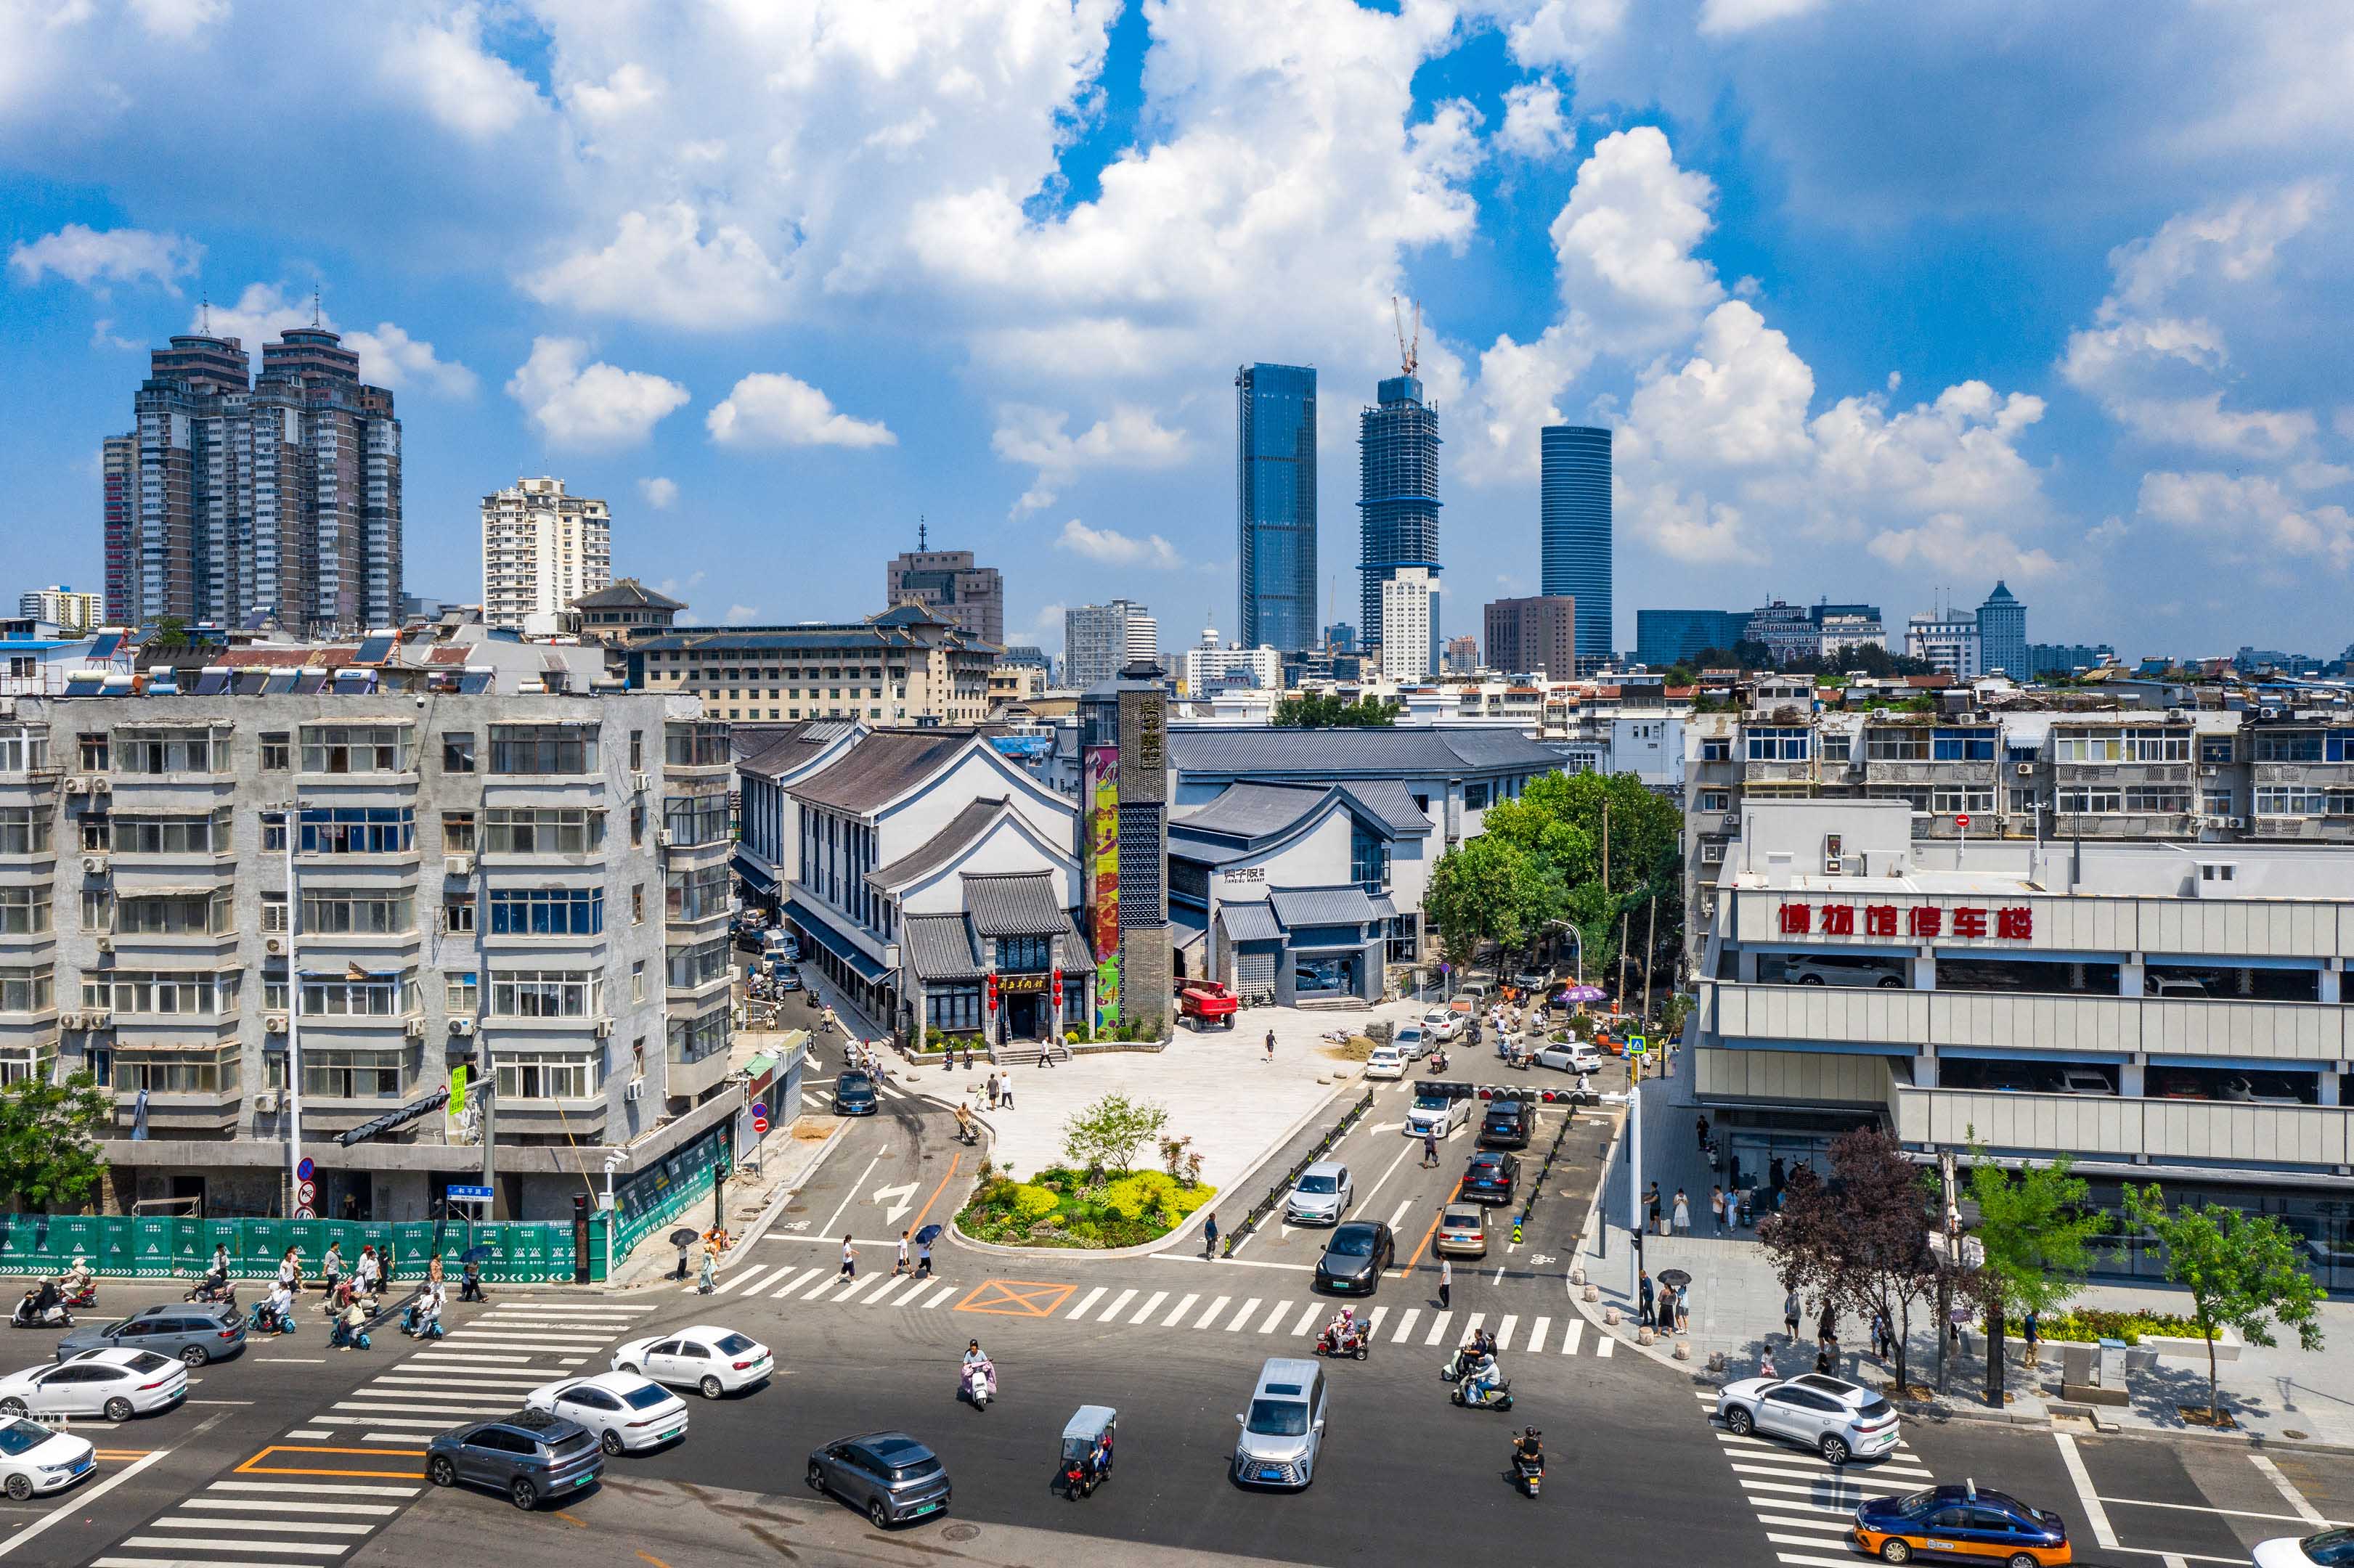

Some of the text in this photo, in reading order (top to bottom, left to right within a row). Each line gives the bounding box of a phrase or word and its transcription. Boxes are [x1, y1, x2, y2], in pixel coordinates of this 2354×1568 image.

[1778, 903, 2032, 940] 博物馆停车楼
